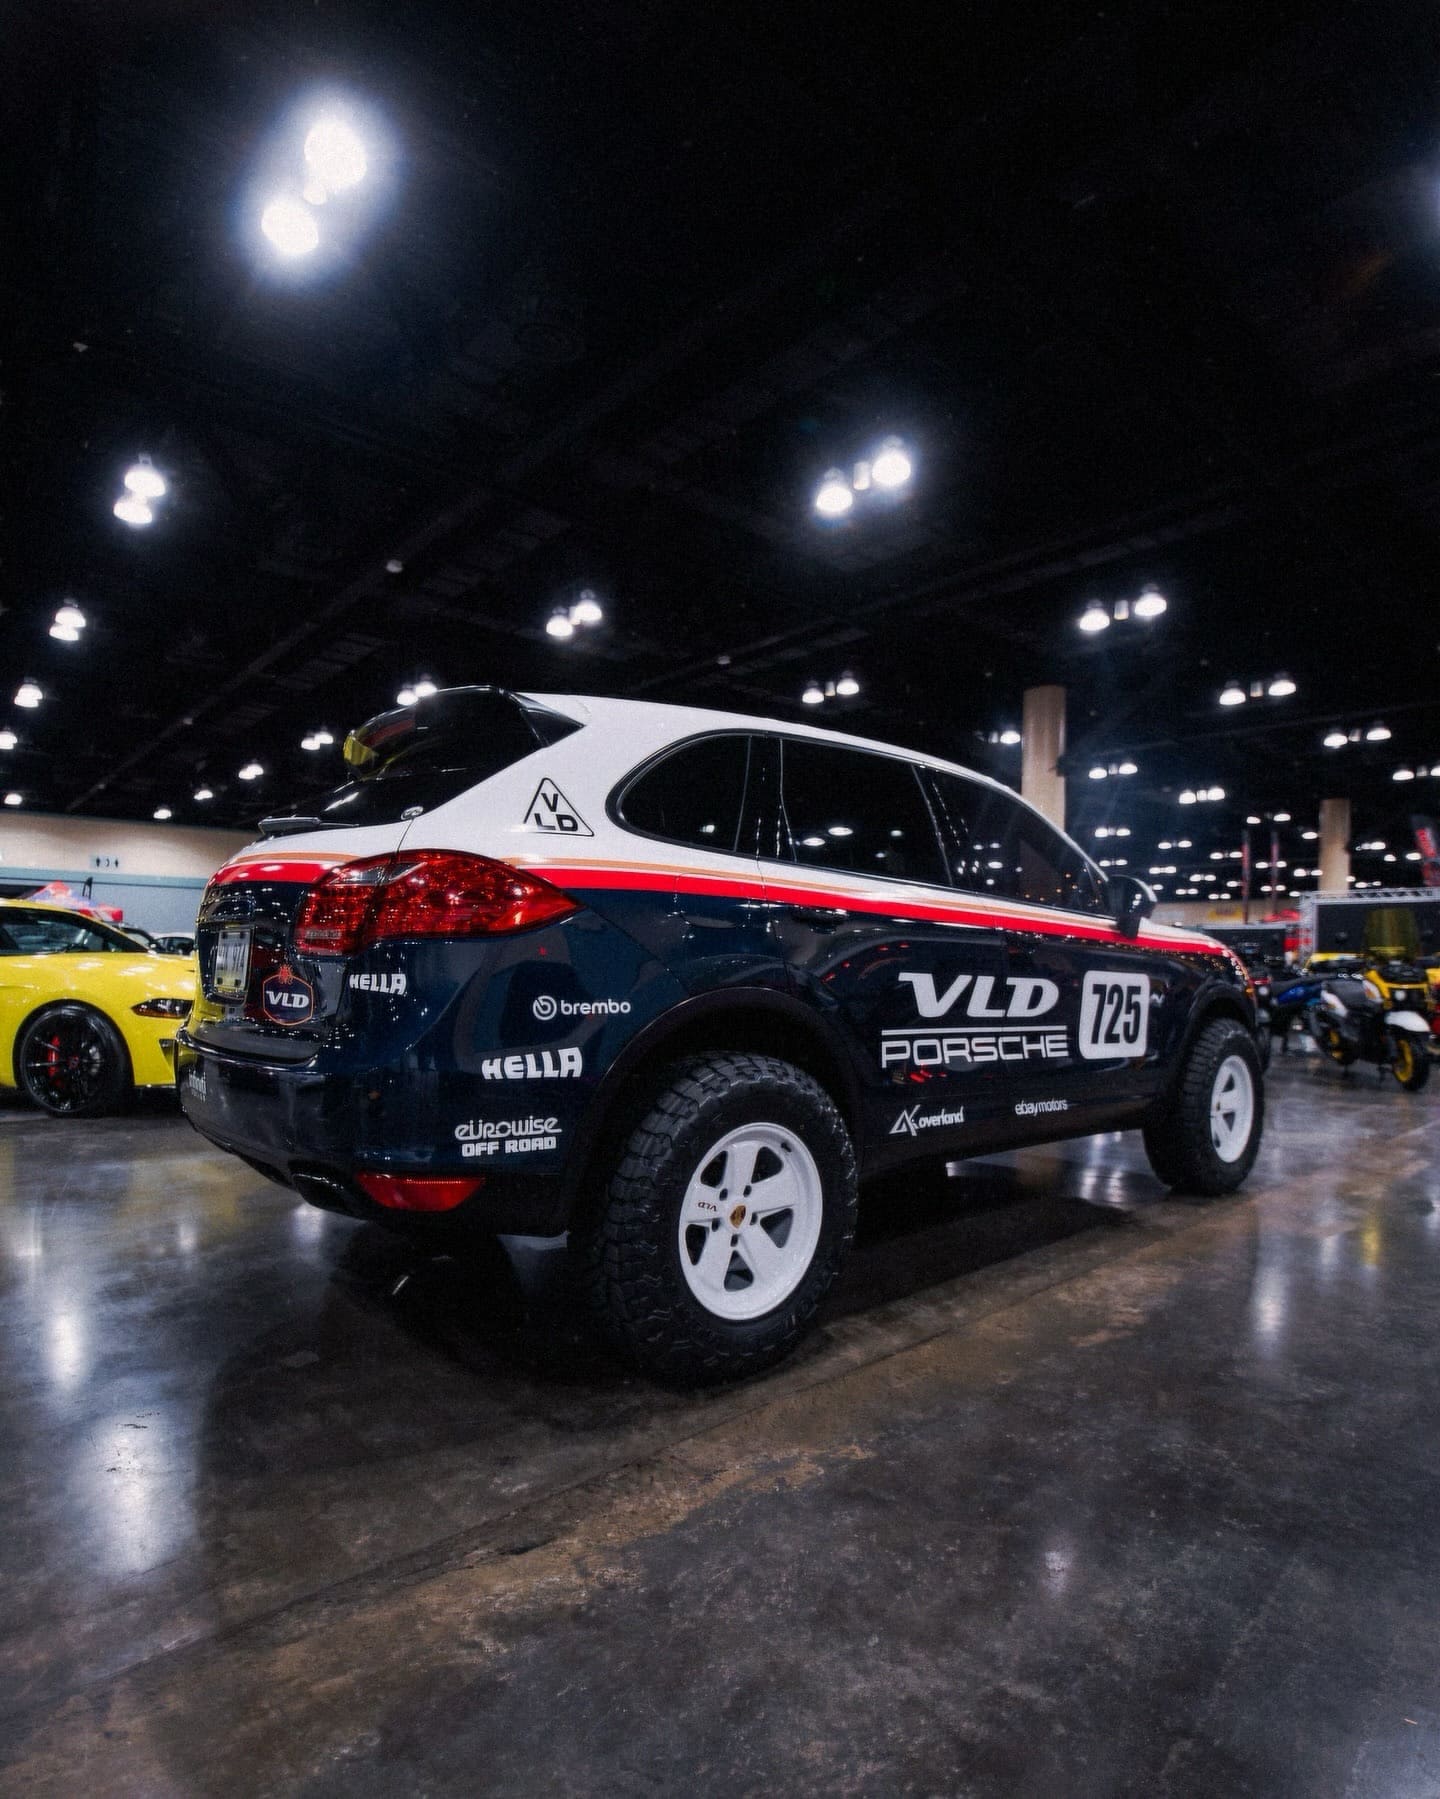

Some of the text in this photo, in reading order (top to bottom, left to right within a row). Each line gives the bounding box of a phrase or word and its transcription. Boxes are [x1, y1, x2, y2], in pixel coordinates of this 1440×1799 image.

[349, 973, 407, 995] HELLA
[898, 972, 1059, 1018] VLD
[265, 990, 310, 1008] VLD
[560, 999, 631, 1015] brembo
[1091, 984, 1141, 1044] 725
[881, 1034, 1068, 1068] PORSCHE
[481, 1047, 583, 1080] HELLA
[918, 1105, 964, 1129] overland
[461, 1136, 557, 1157] OFF ROAD
[697, 1201, 717, 1212] VLD
